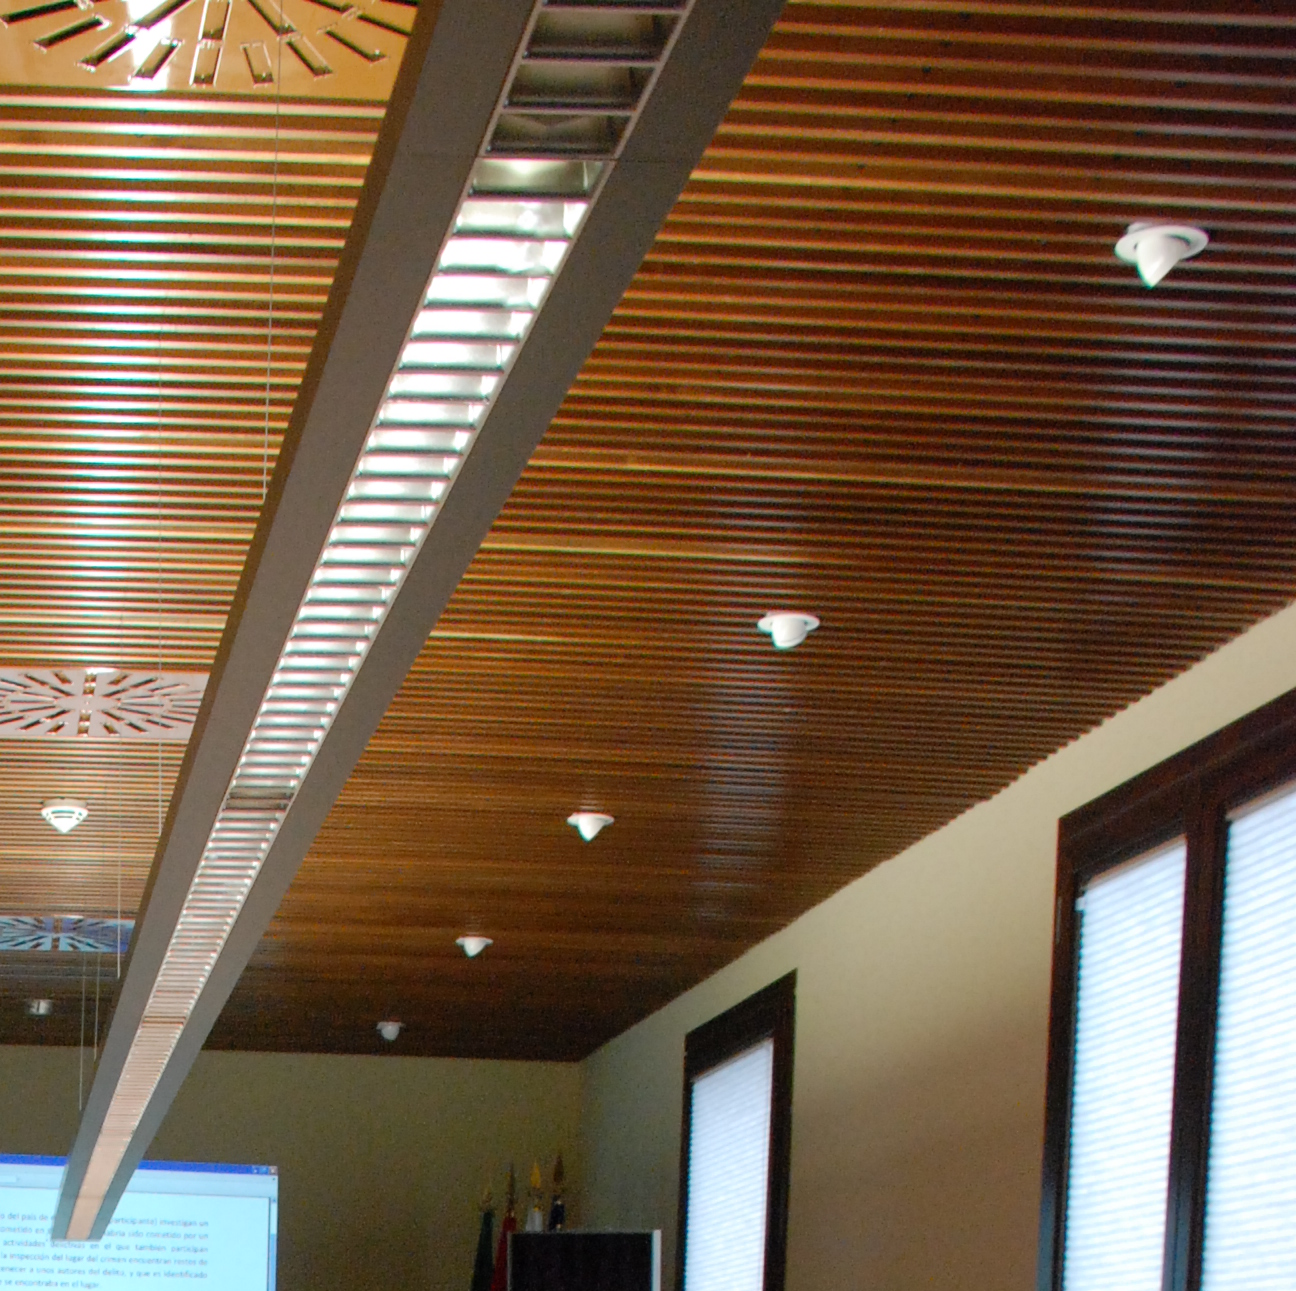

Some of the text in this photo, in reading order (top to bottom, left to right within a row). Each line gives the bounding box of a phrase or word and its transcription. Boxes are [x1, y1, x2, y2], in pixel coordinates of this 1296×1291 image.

[7, 1212, 19, 1220] del
[105, 1229, 125, 1237] abría
[183, 1232, 196, 1240] por
[115, 1243, 129, 1251] que
[51, 1253, 63, 1261] del
[86, 1254, 98, 1263] del
[88, 1267, 100, 1275] del
